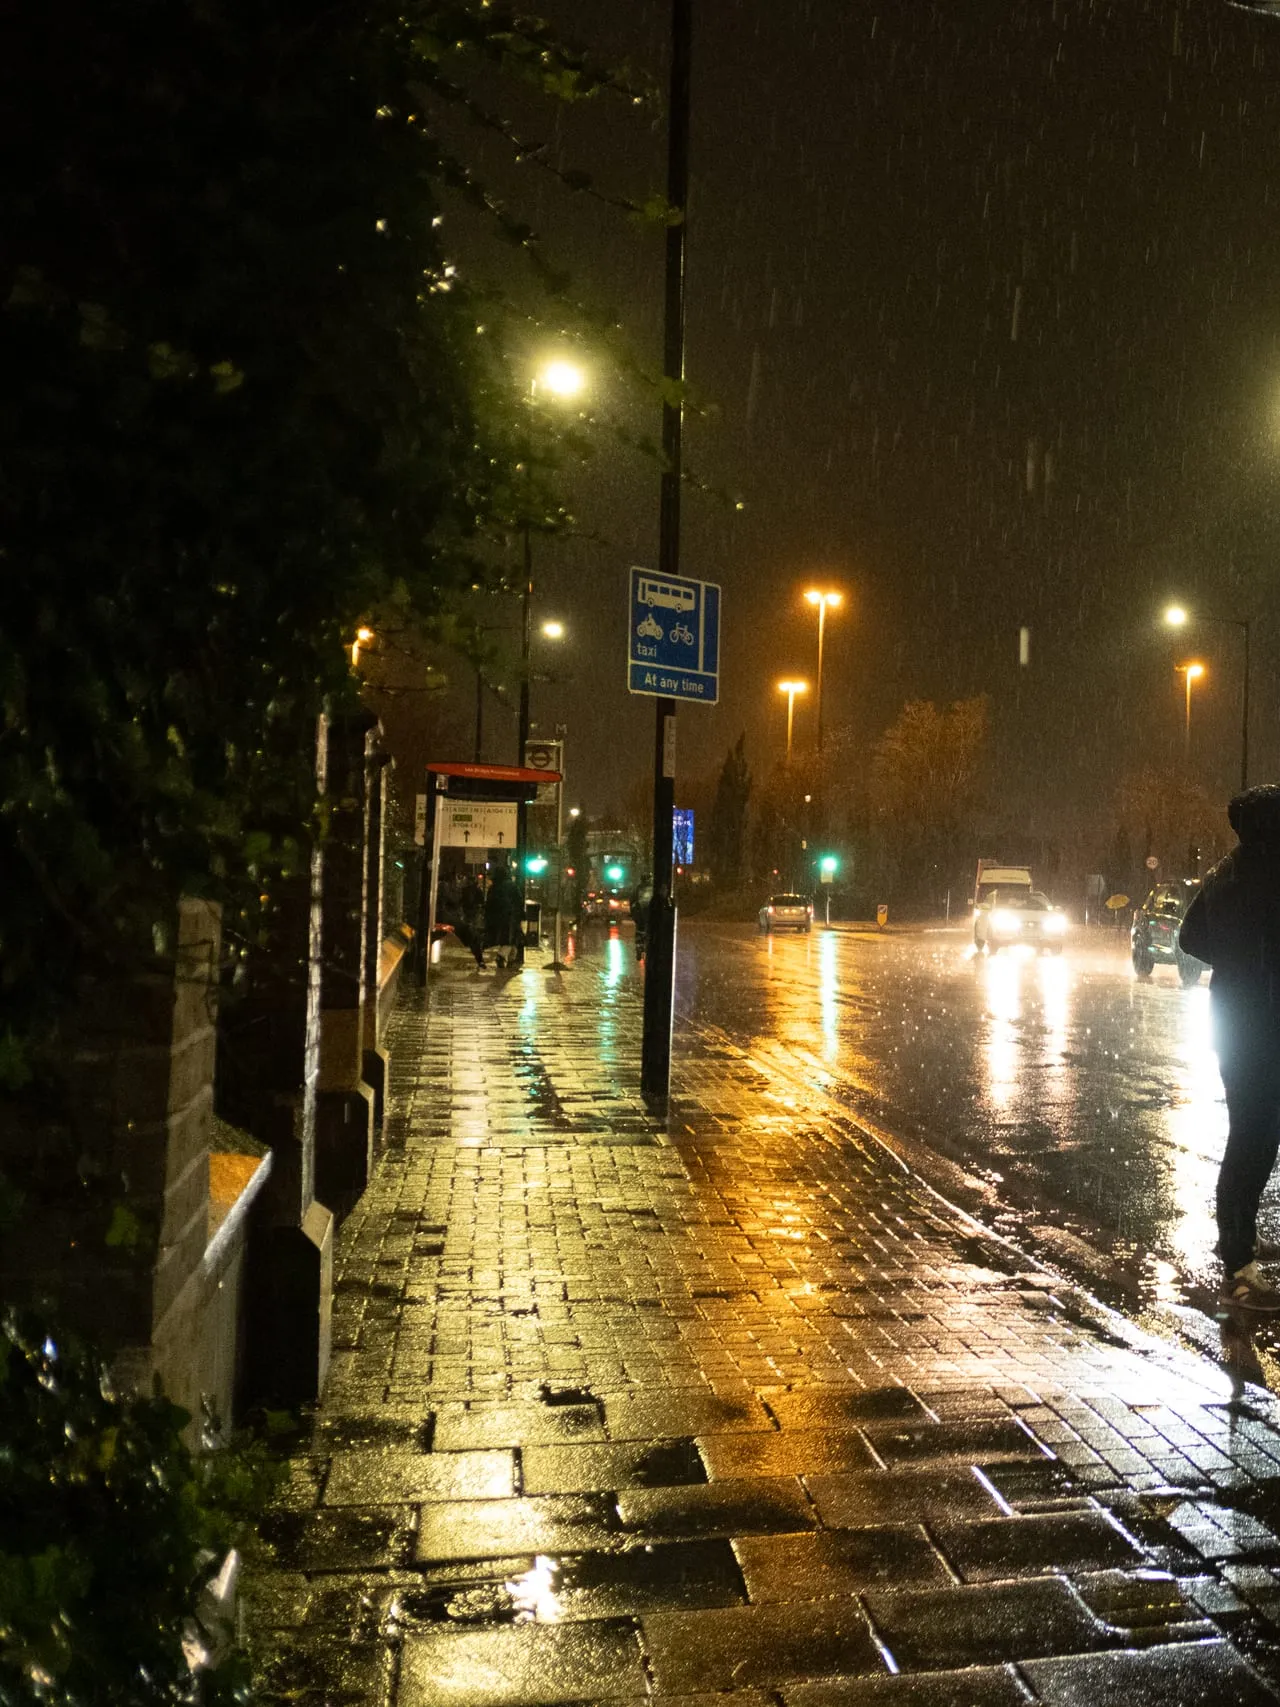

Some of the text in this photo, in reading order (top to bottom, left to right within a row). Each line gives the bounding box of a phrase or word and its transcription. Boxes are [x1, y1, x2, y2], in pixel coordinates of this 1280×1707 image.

[636, 642, 658, 658] taxi
[644, 672, 705, 694] At any time
[555, 723, 568, 735] M
